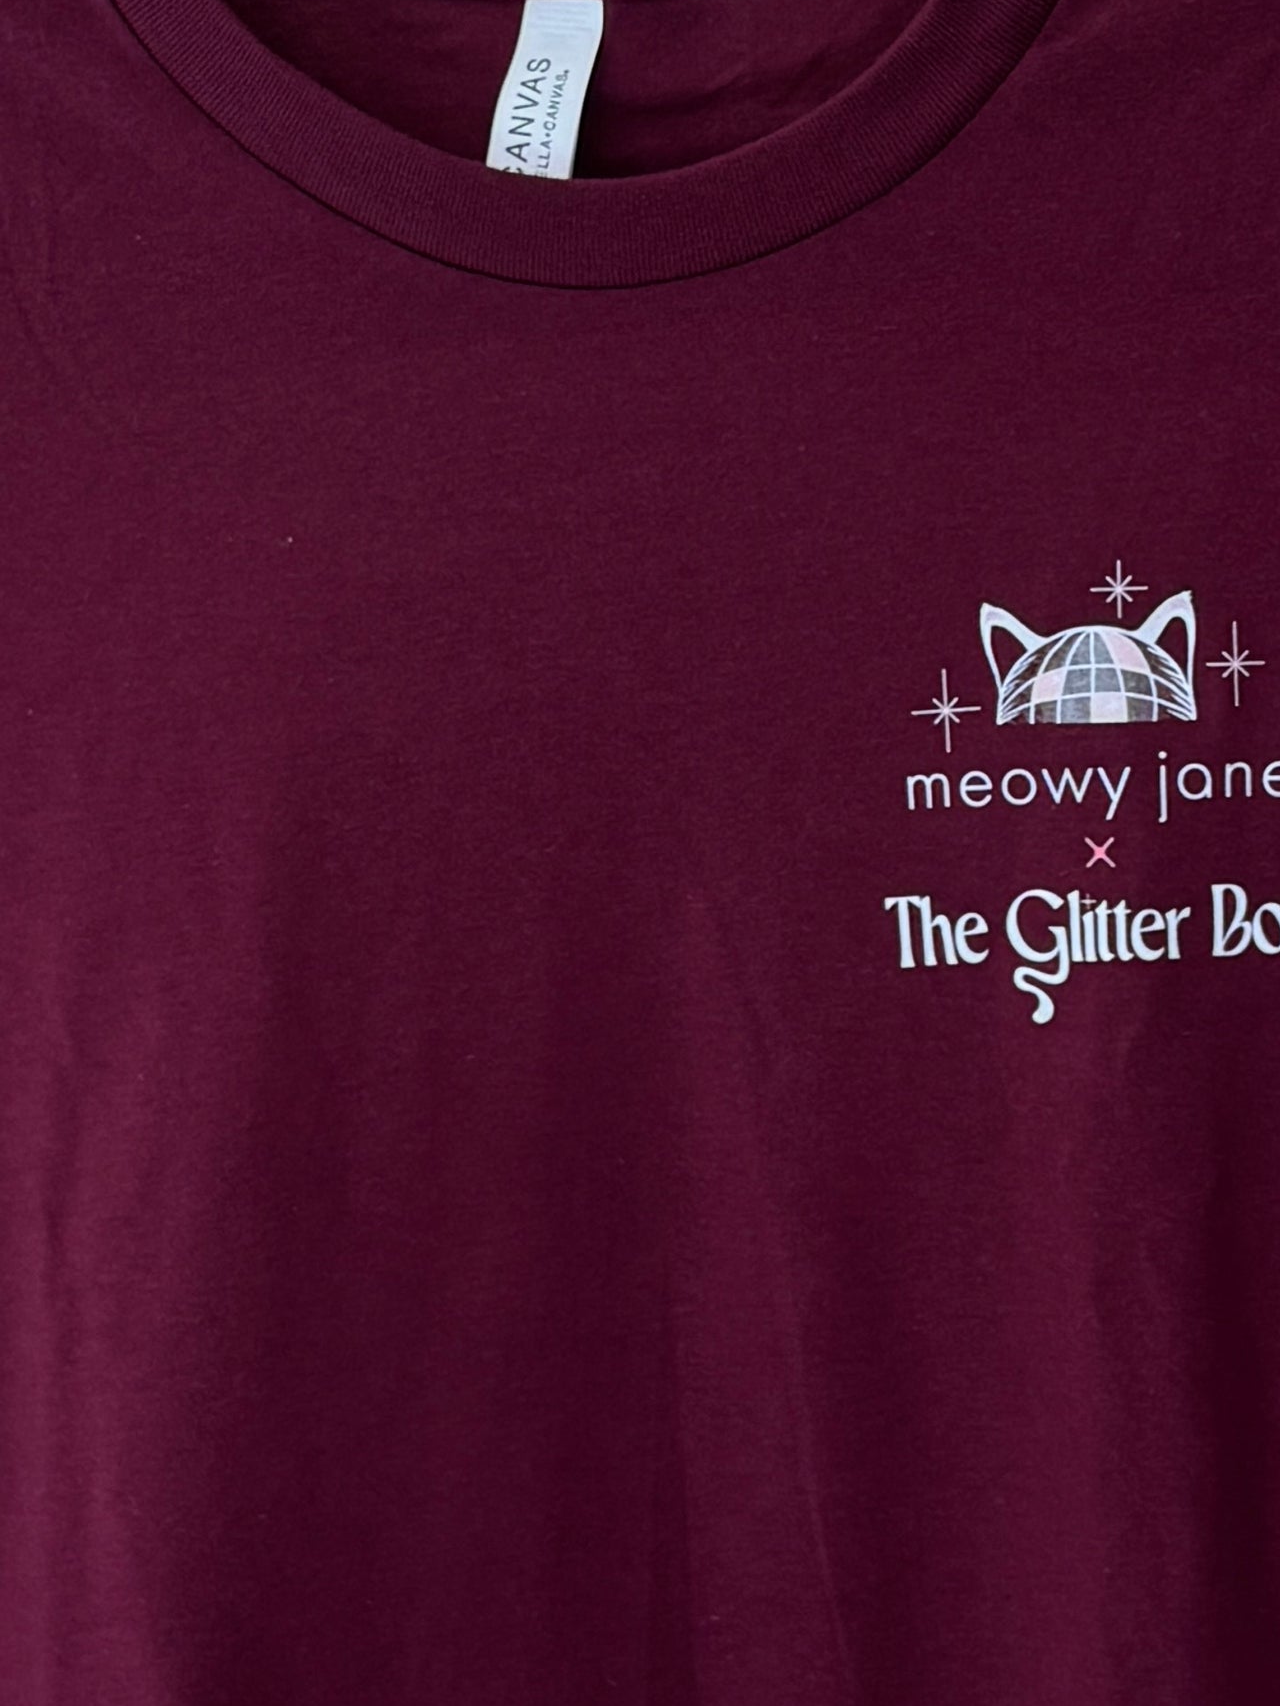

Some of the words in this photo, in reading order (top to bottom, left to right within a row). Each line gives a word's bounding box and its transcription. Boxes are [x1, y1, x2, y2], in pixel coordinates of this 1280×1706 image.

[906, 766, 1132, 822] meowy
[883, 895, 990, 969] The
[1005, 888, 1192, 1025] Glitter
